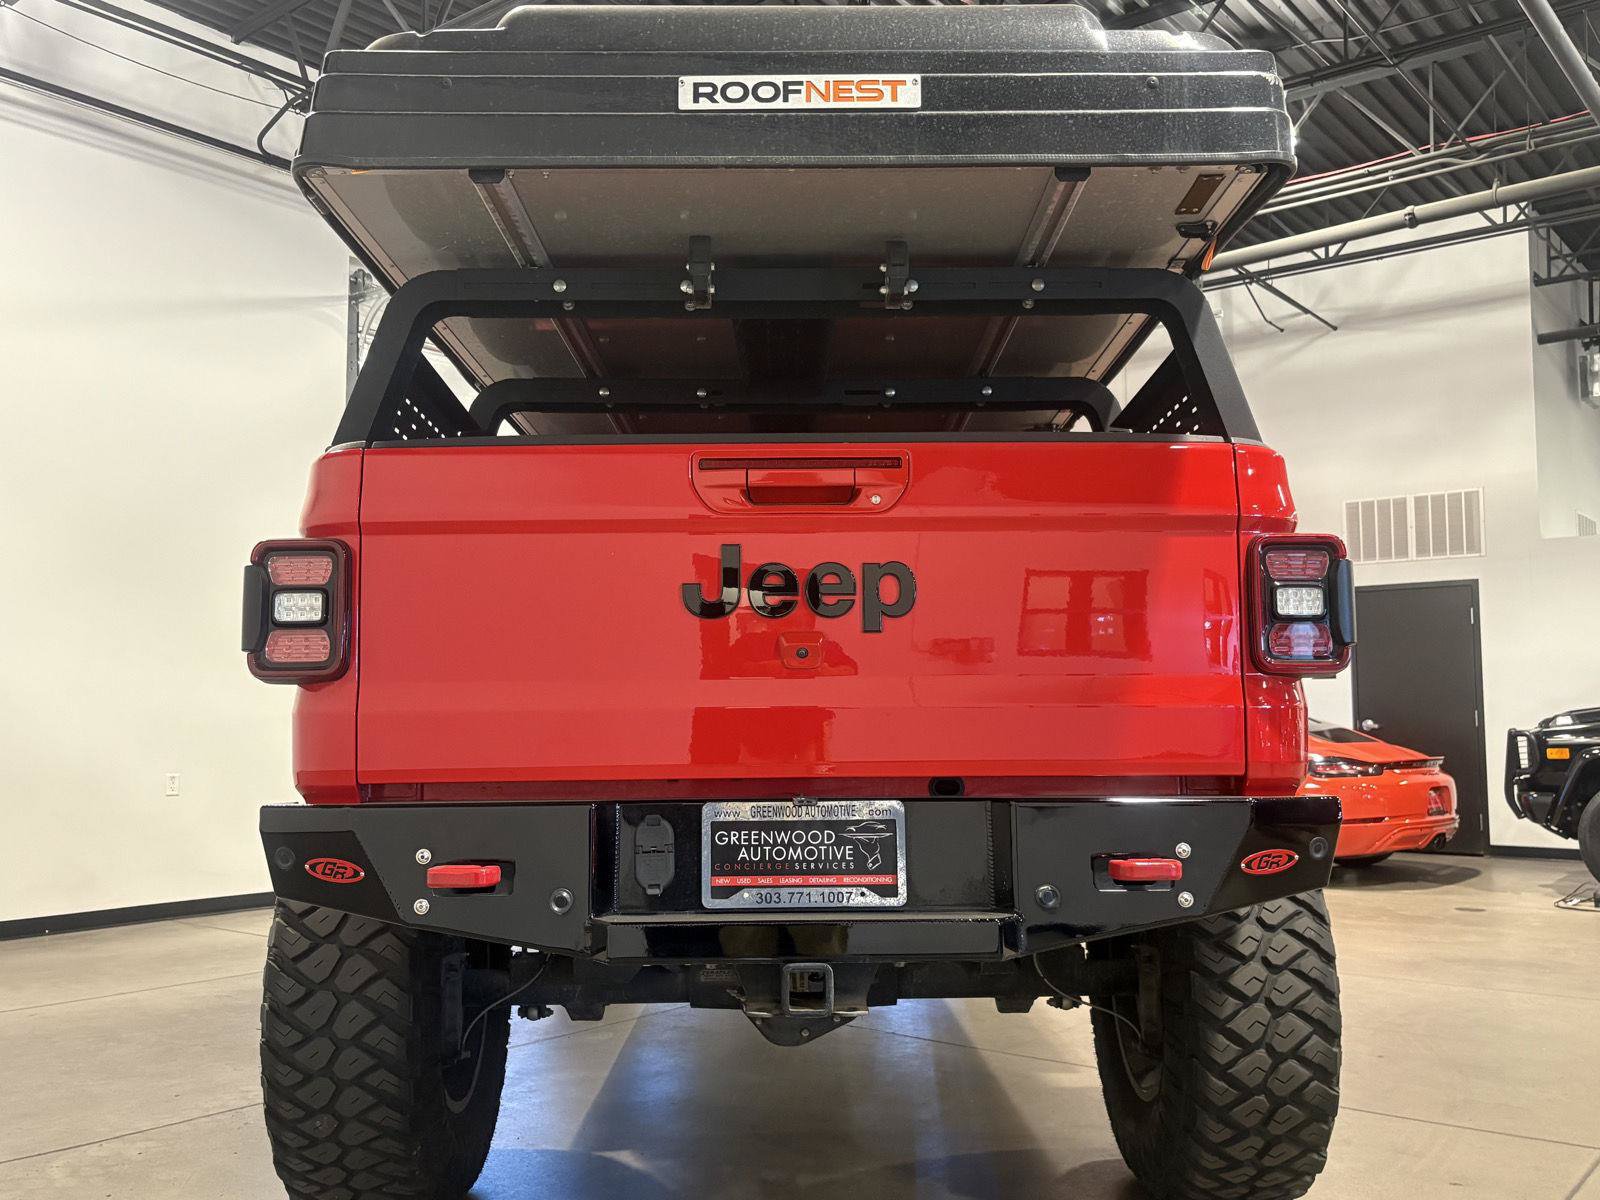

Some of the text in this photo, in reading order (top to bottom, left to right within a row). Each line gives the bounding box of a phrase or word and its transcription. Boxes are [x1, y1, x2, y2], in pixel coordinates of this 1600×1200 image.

[692, 80, 907, 103] ROOFNEST
[681, 543, 917, 634] Jeep
[750, 805, 803, 818] GREENWOOD
[804, 804, 857, 818] AUTOMOTIVE
[714, 830, 836, 846] GREENWOOD
[737, 846, 854, 861] AUTOMOTIVE
[714, 862, 855, 871] CONCIERGE SERVICES
[843, 876, 893, 884] RECONDITIONING
[755, 890, 854, 904] 303.771.1007
